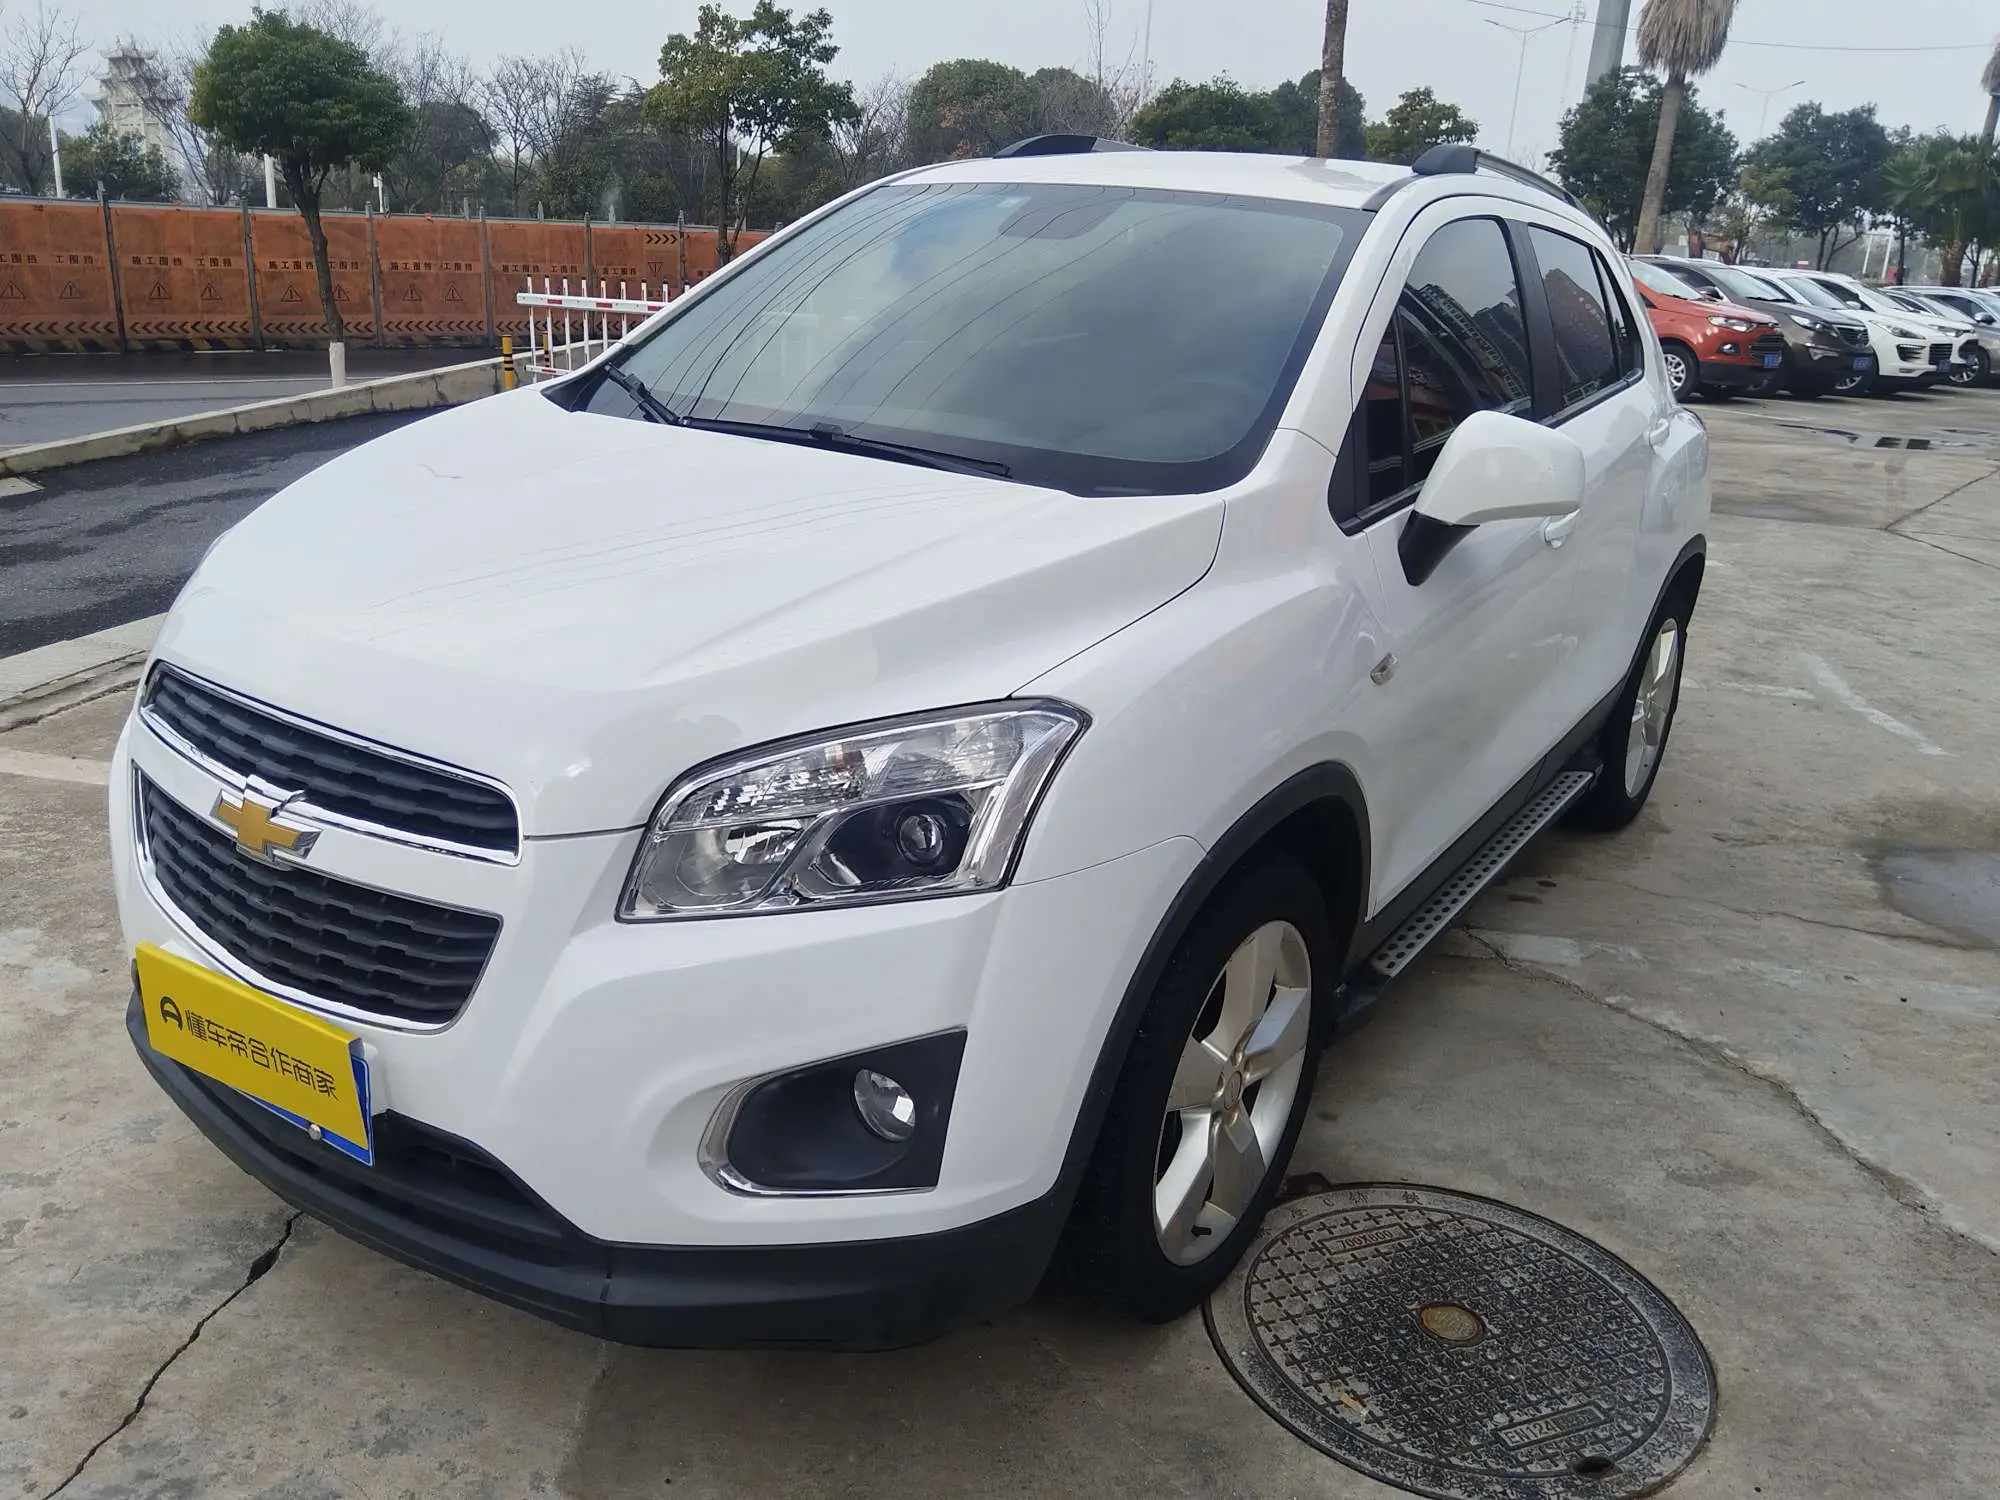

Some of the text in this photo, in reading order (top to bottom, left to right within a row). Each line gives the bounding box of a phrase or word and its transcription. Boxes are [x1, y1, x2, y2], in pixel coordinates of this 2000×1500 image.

[186, 1009, 339, 1100] 懂车帝合作商家
